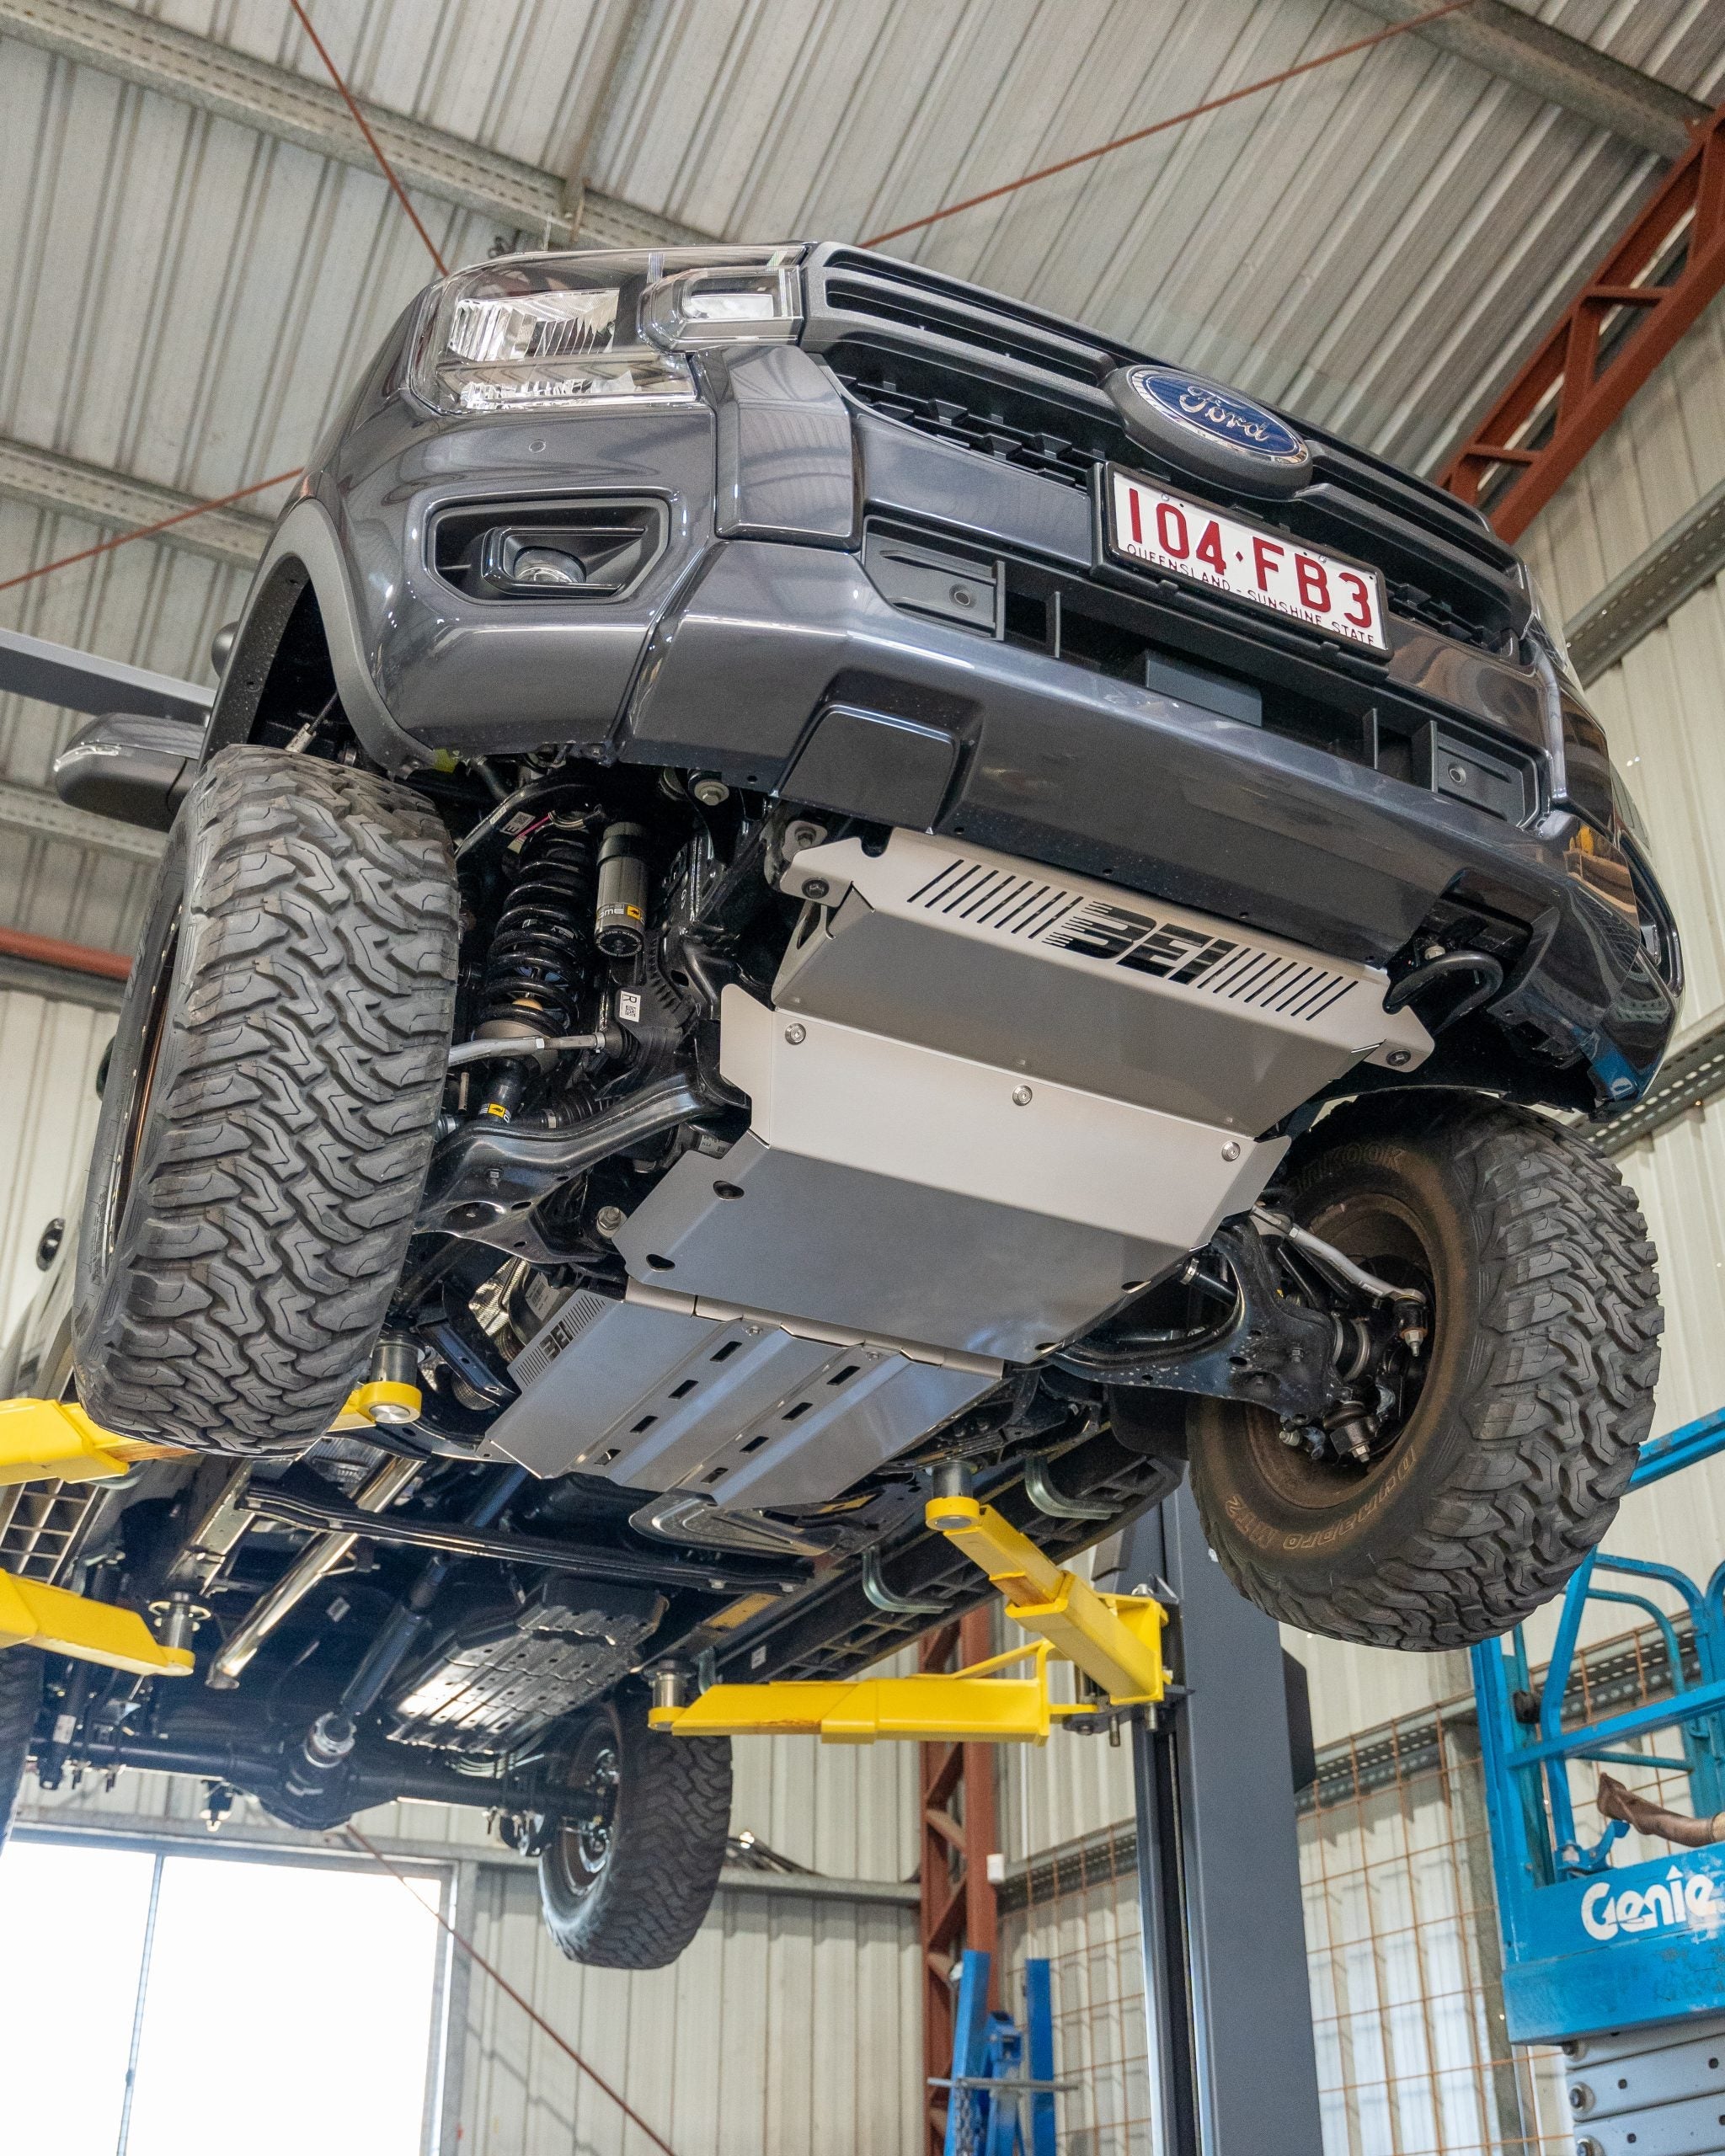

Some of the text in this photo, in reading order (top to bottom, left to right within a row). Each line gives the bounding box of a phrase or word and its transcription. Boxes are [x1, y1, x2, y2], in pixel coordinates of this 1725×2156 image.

[1179, 386, 1272, 442] Ford
[1127, 543, 1231, 591] QUEENSLAND
[1247, 590, 1322, 626] SUNSHINE
[1332, 621, 1375, 645] STATE
[1580, 1864, 1717, 1940] Genie
